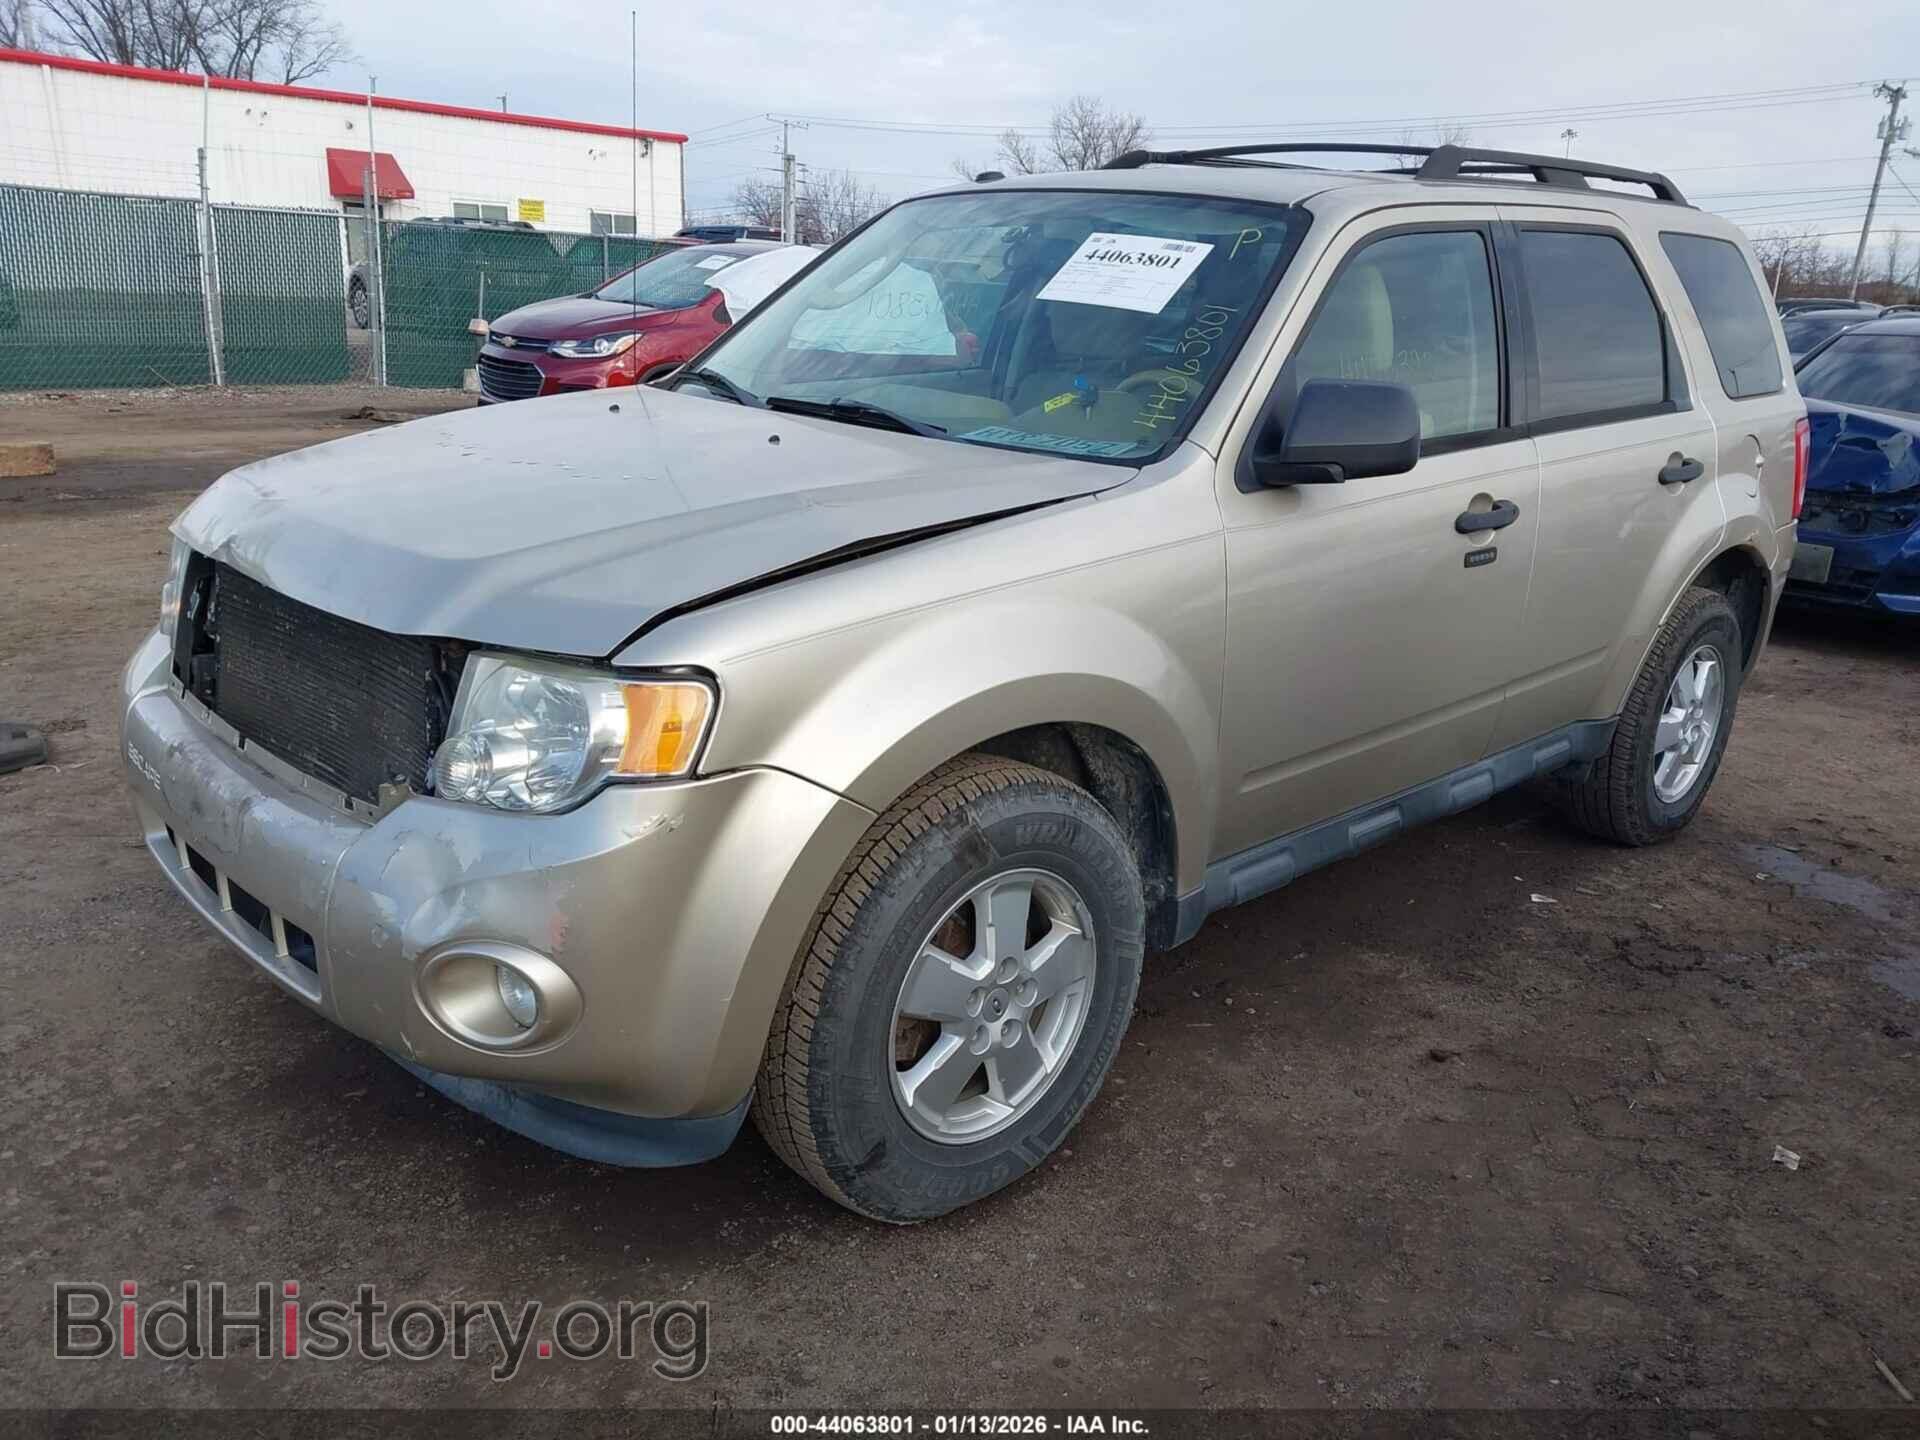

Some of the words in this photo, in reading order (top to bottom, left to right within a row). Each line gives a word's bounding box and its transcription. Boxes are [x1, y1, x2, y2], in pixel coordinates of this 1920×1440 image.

[1084, 249, 1183, 269] 44063801
[1228, 228, 1262, 260] P
[1132, 304, 1239, 429] 44063801
